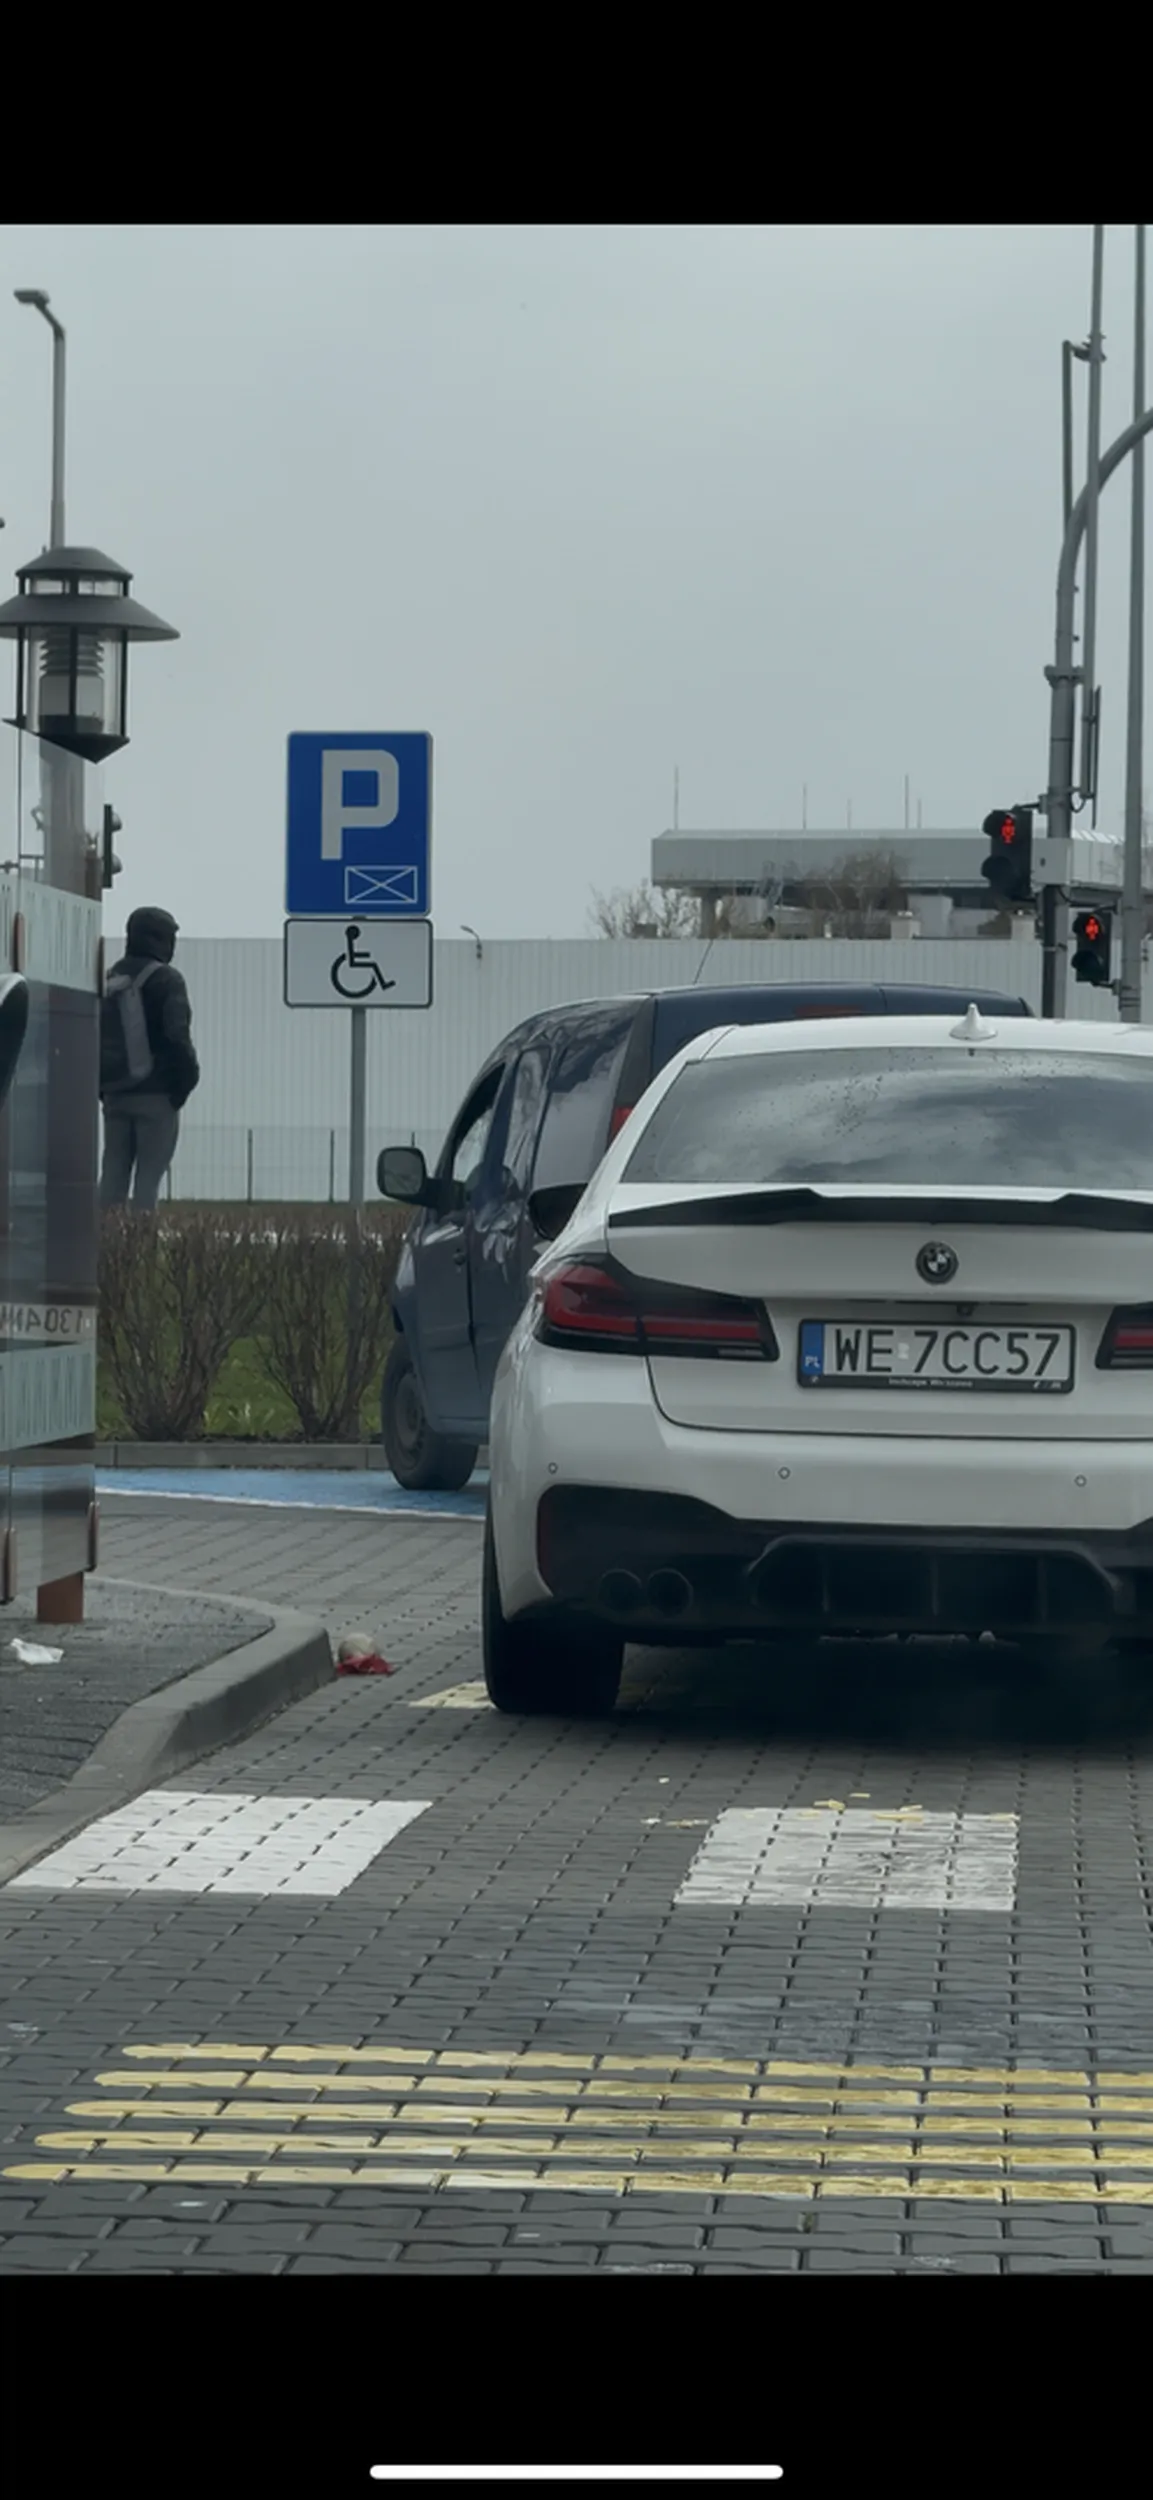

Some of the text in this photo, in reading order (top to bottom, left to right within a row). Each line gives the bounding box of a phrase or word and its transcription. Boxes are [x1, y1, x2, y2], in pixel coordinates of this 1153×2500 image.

[321, 750, 399, 860] P
[804, 1355, 820, 1368] PL
[835, 1328, 1061, 1376] WE 7CC57
